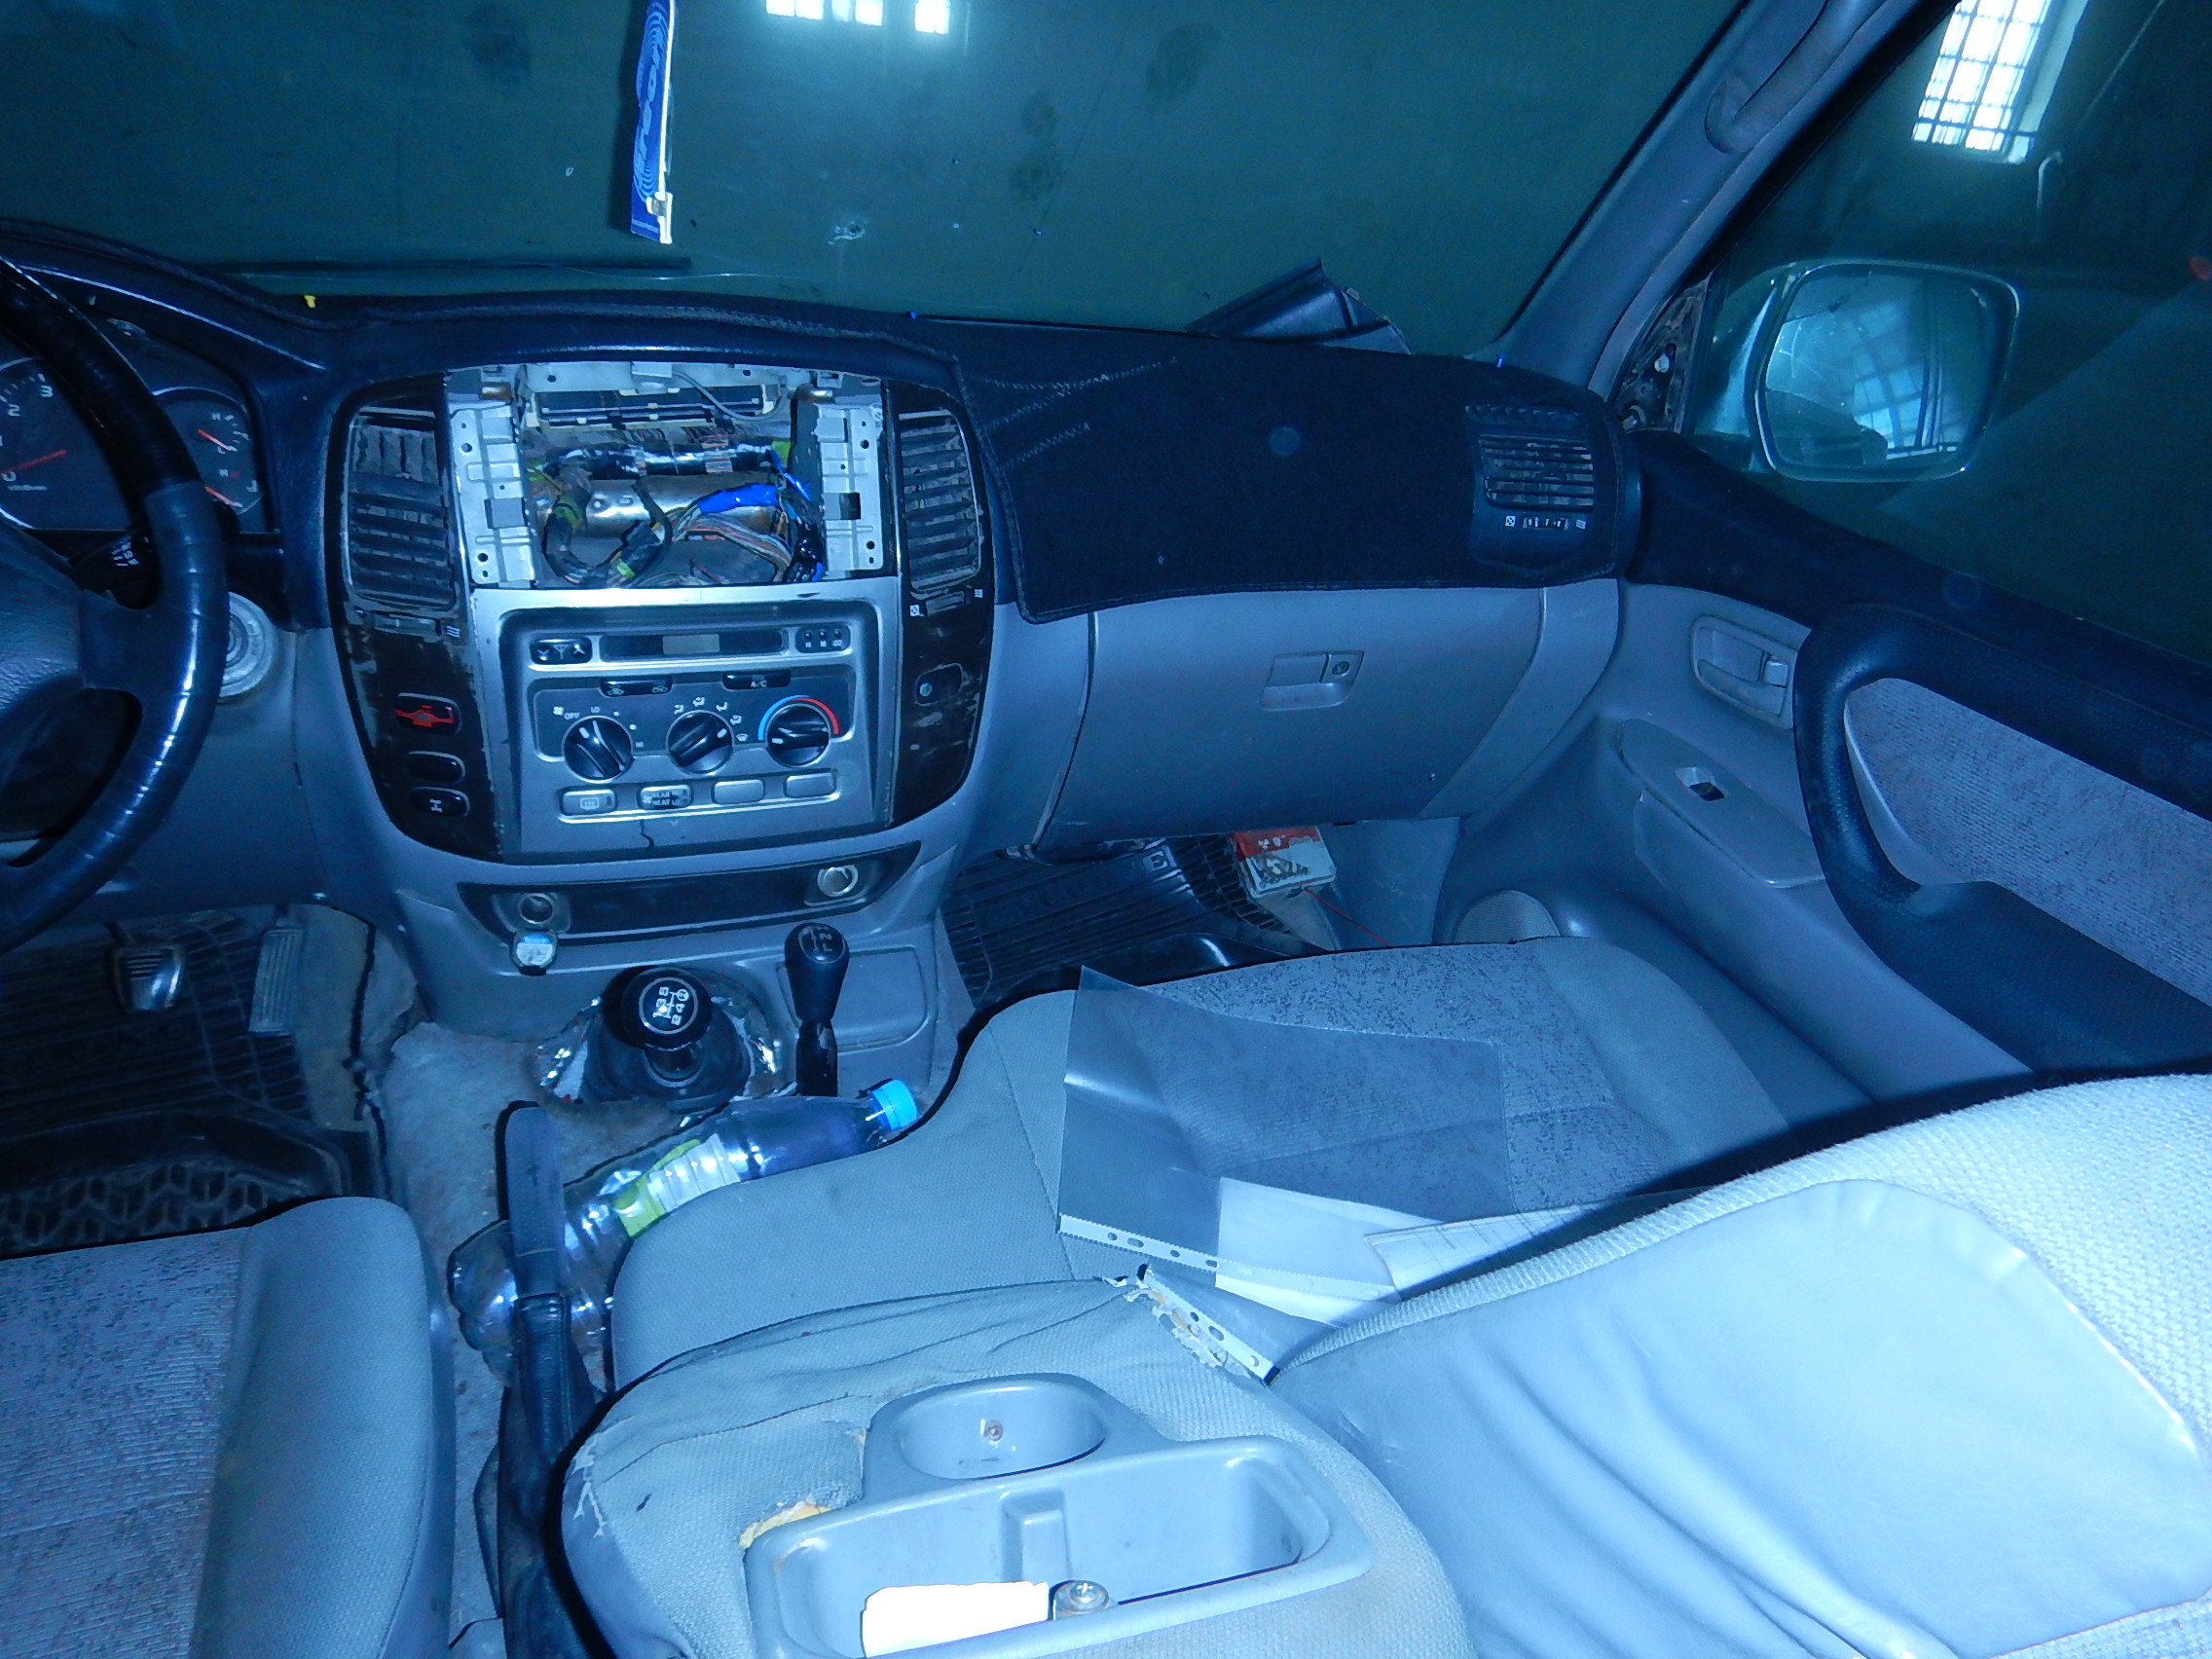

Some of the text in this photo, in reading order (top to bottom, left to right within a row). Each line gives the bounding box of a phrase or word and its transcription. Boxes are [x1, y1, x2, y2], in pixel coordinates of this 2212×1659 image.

[40, 385, 53, 397] 3
[8, 403, 20, 417] 2
[564, 712, 580, 720] OFF
[675, 1003, 685, 1014] 4
[671, 1014, 682, 1026] 2
